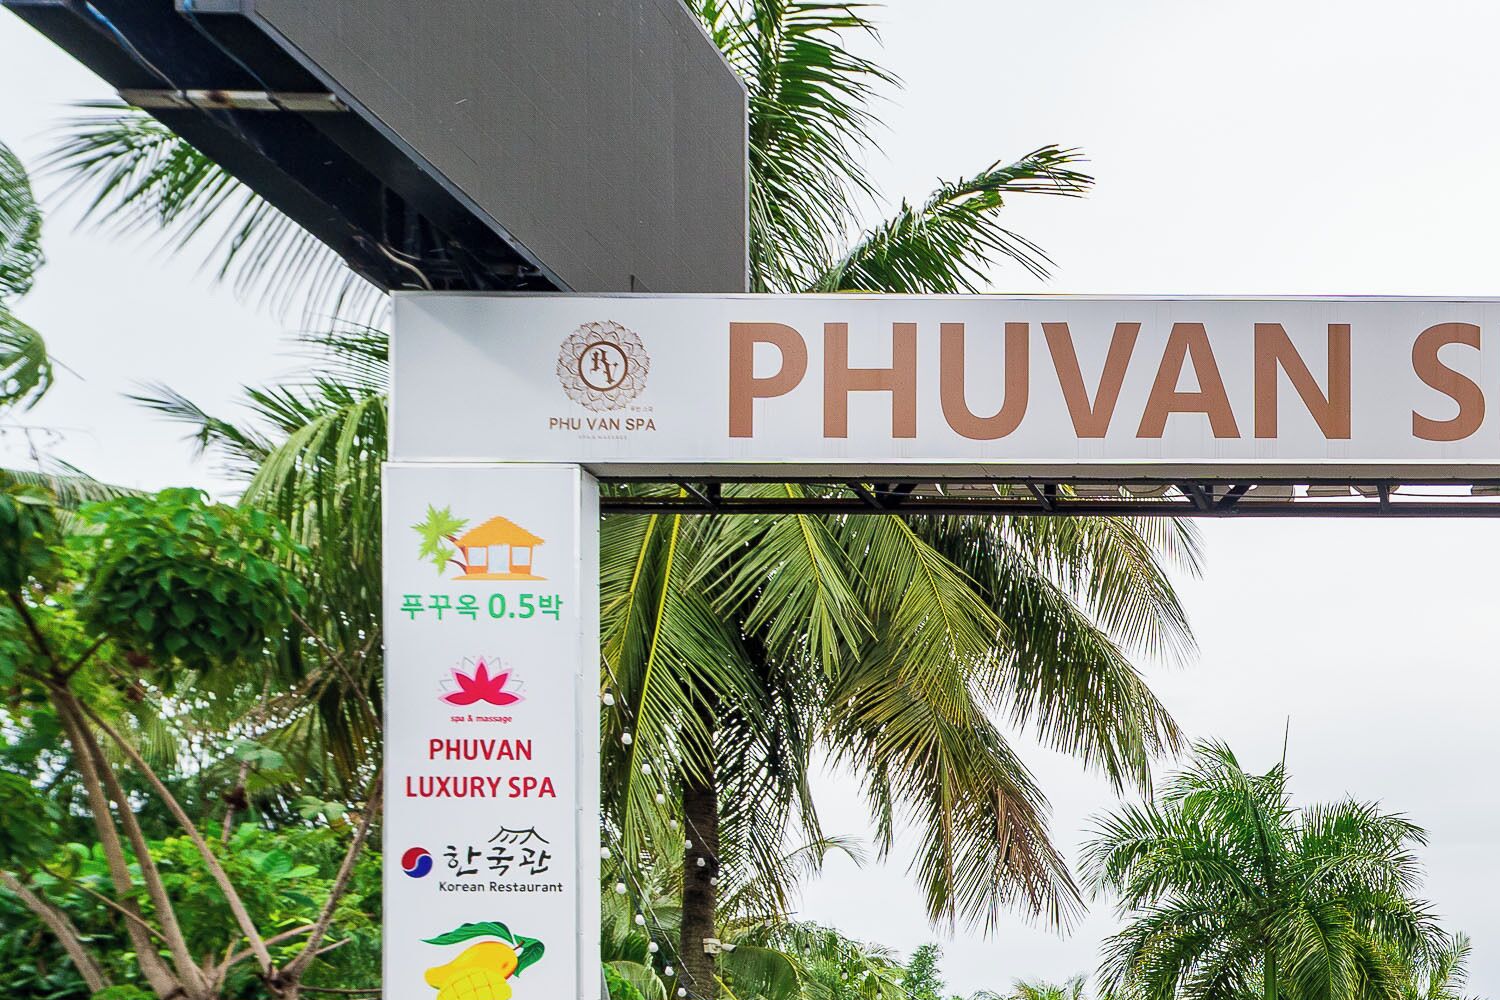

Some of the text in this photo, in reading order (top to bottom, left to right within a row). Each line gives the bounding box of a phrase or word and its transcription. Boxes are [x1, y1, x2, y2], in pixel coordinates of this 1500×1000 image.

[729, 321, 1352, 441] PHUVAN
[549, 417, 656, 431] PHU VAN SPA
[400, 593, 563, 621] 푸꾸옥 0.5박
[450, 714, 512, 724] spa & massage
[429, 739, 532, 761] PHUVAN
[406, 776, 557, 799] LUXURY SPA
[443, 845, 551, 876] 한국관
[439, 881, 563, 893] Korean Restaurant
